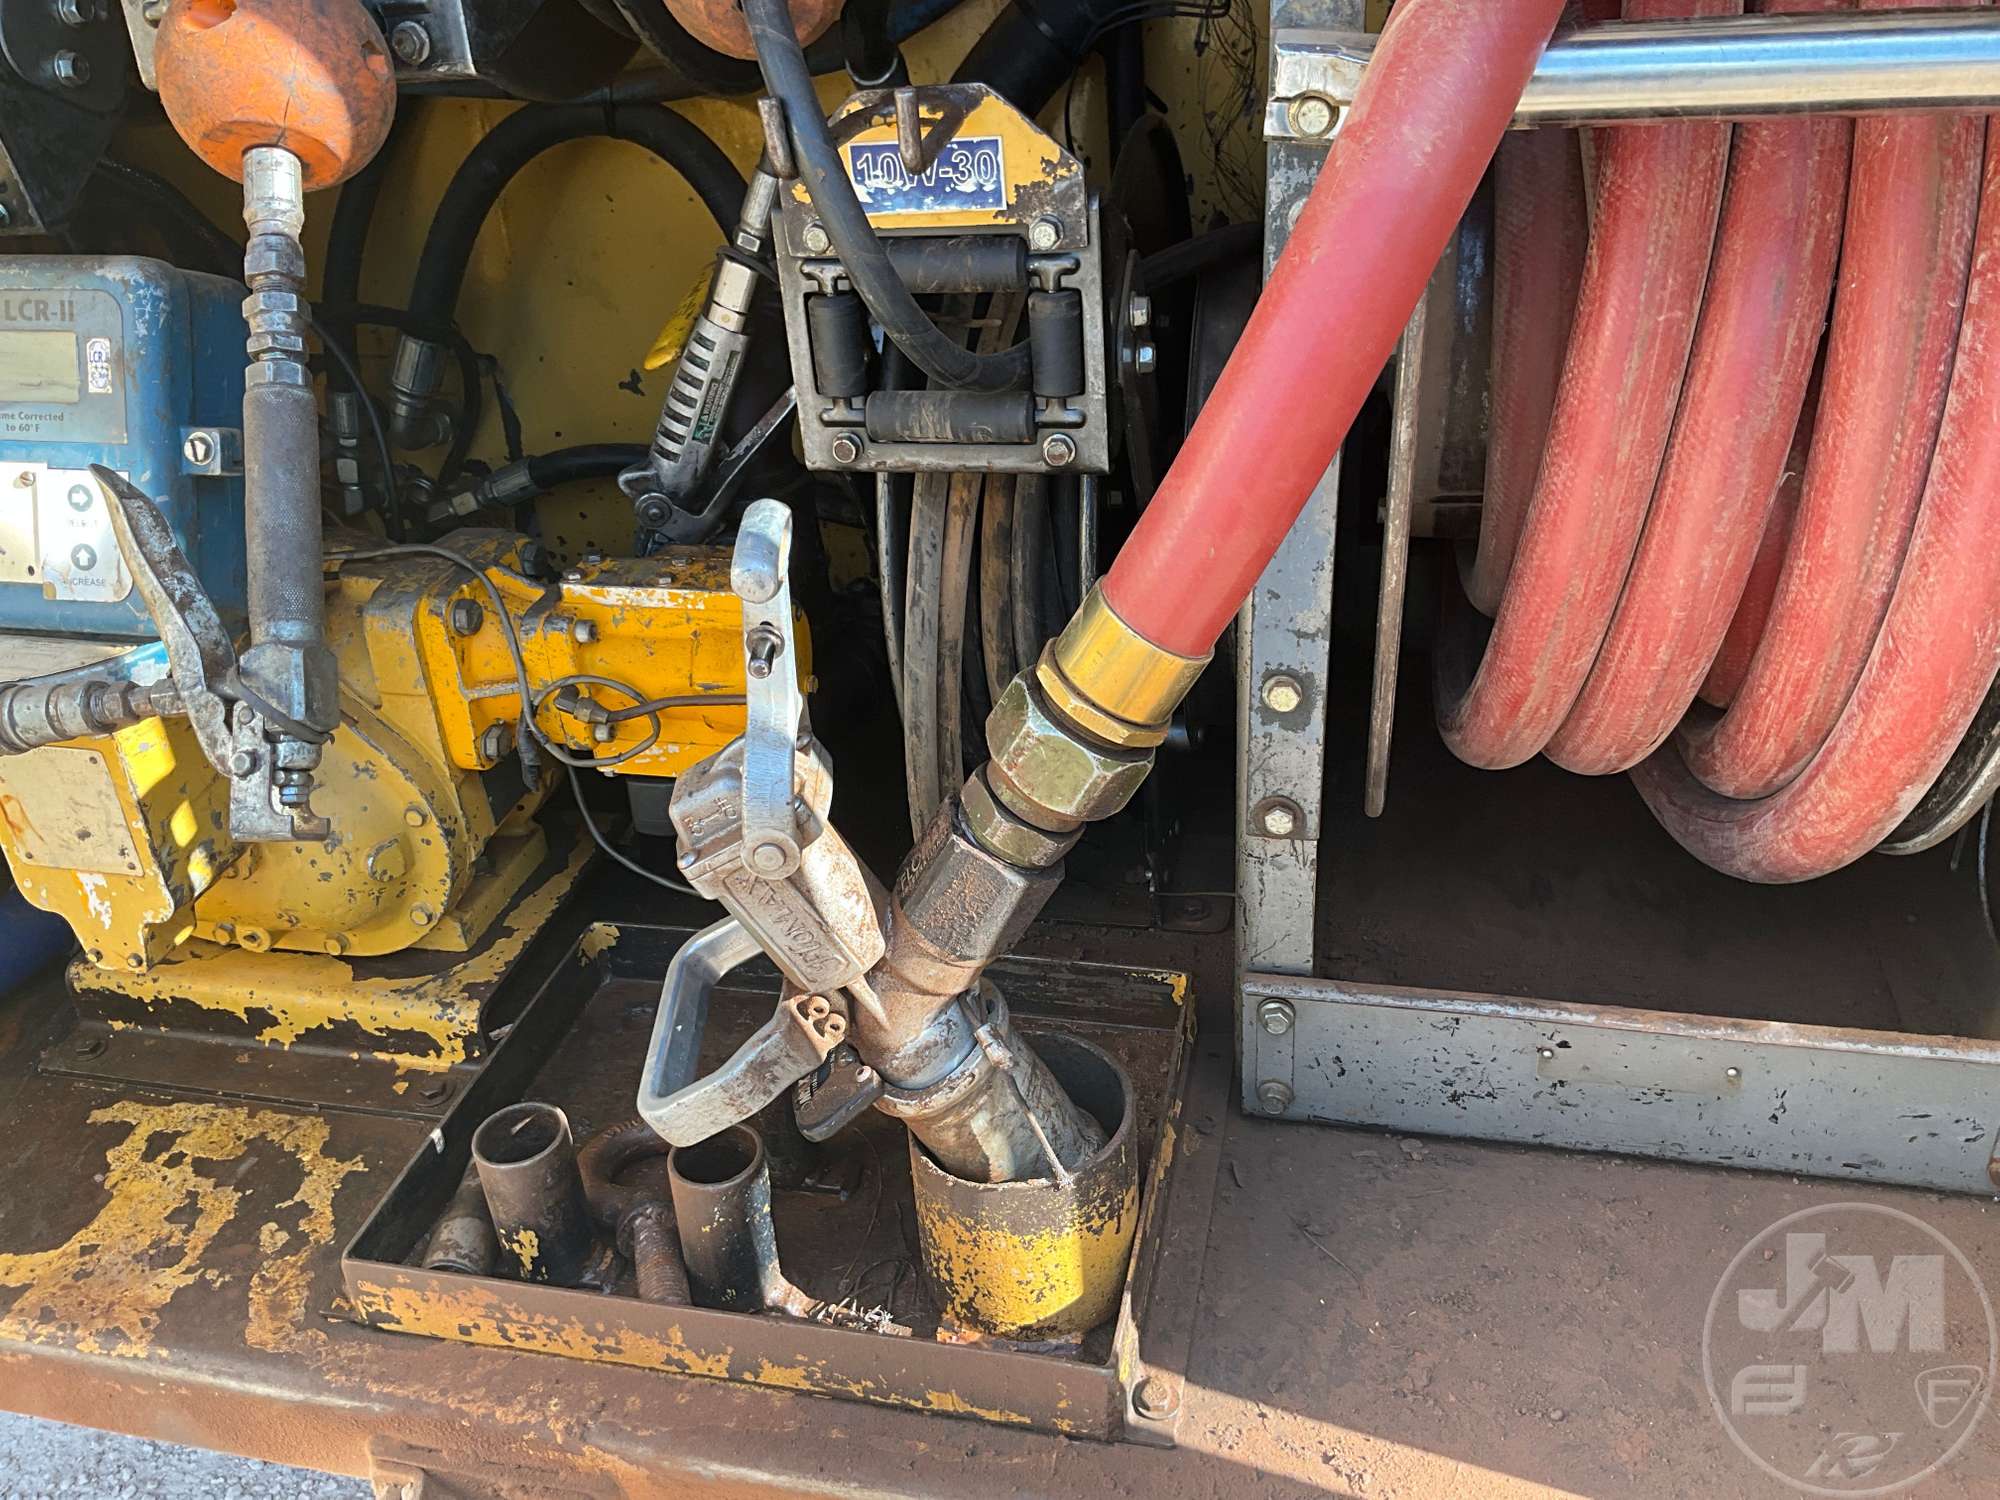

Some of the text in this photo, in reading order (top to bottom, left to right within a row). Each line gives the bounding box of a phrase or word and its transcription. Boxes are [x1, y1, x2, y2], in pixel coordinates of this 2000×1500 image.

[856, 148, 998, 187] 10W-30
[18, 410, 64, 422] Corrected
[6, 423, 16, 432] to
